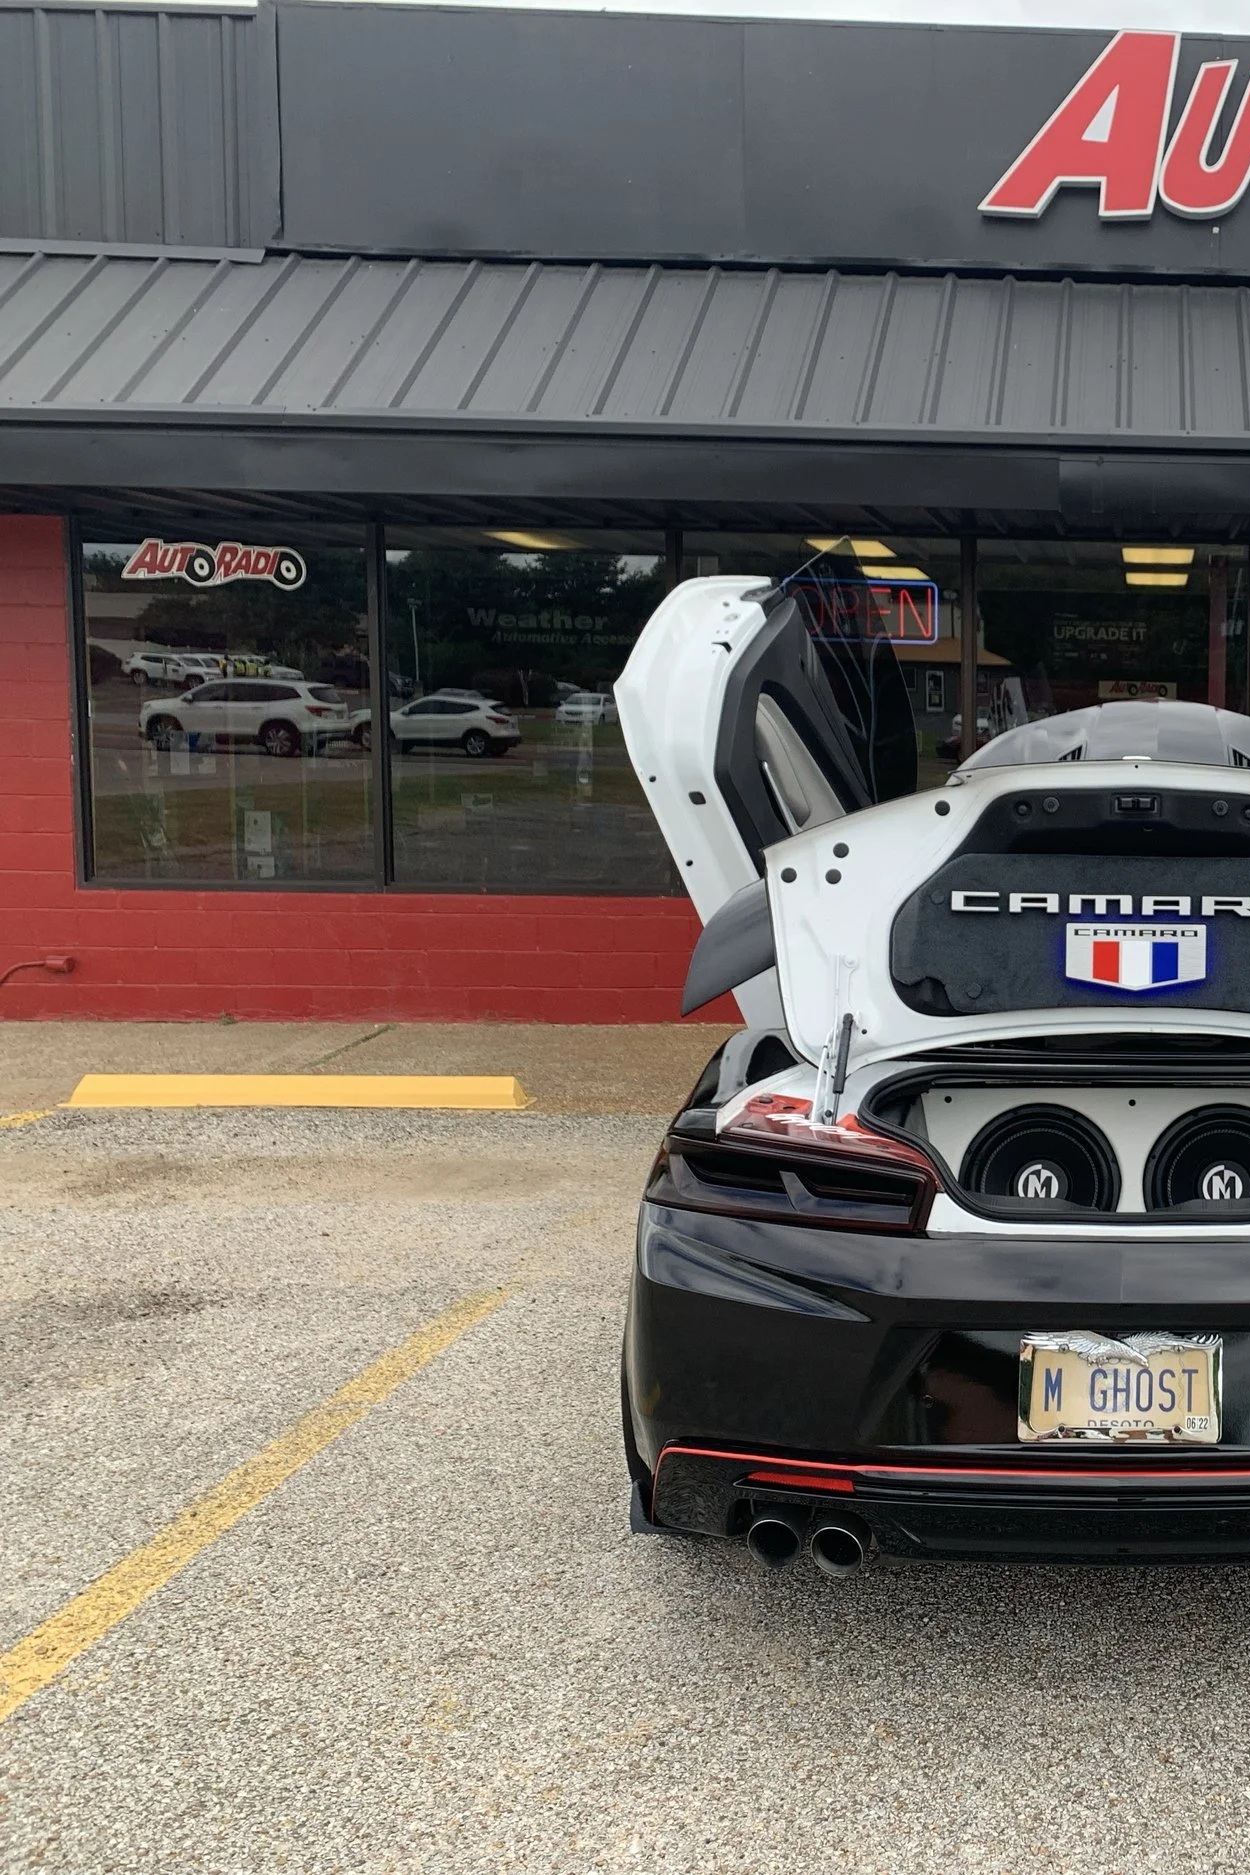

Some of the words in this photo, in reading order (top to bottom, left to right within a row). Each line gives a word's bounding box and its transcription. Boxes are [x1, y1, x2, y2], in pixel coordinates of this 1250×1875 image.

[1052, 625, 1130, 641] UPGRADE
[1131, 627, 1148, 641] IT
[1073, 928, 1200, 939] CAMARO
[1043, 1367, 1063, 1413] M
[1089, 1367, 1199, 1413] GHOST
[1186, 1417, 1197, 1430] 06
[1198, 1418, 1209, 1430] 22
